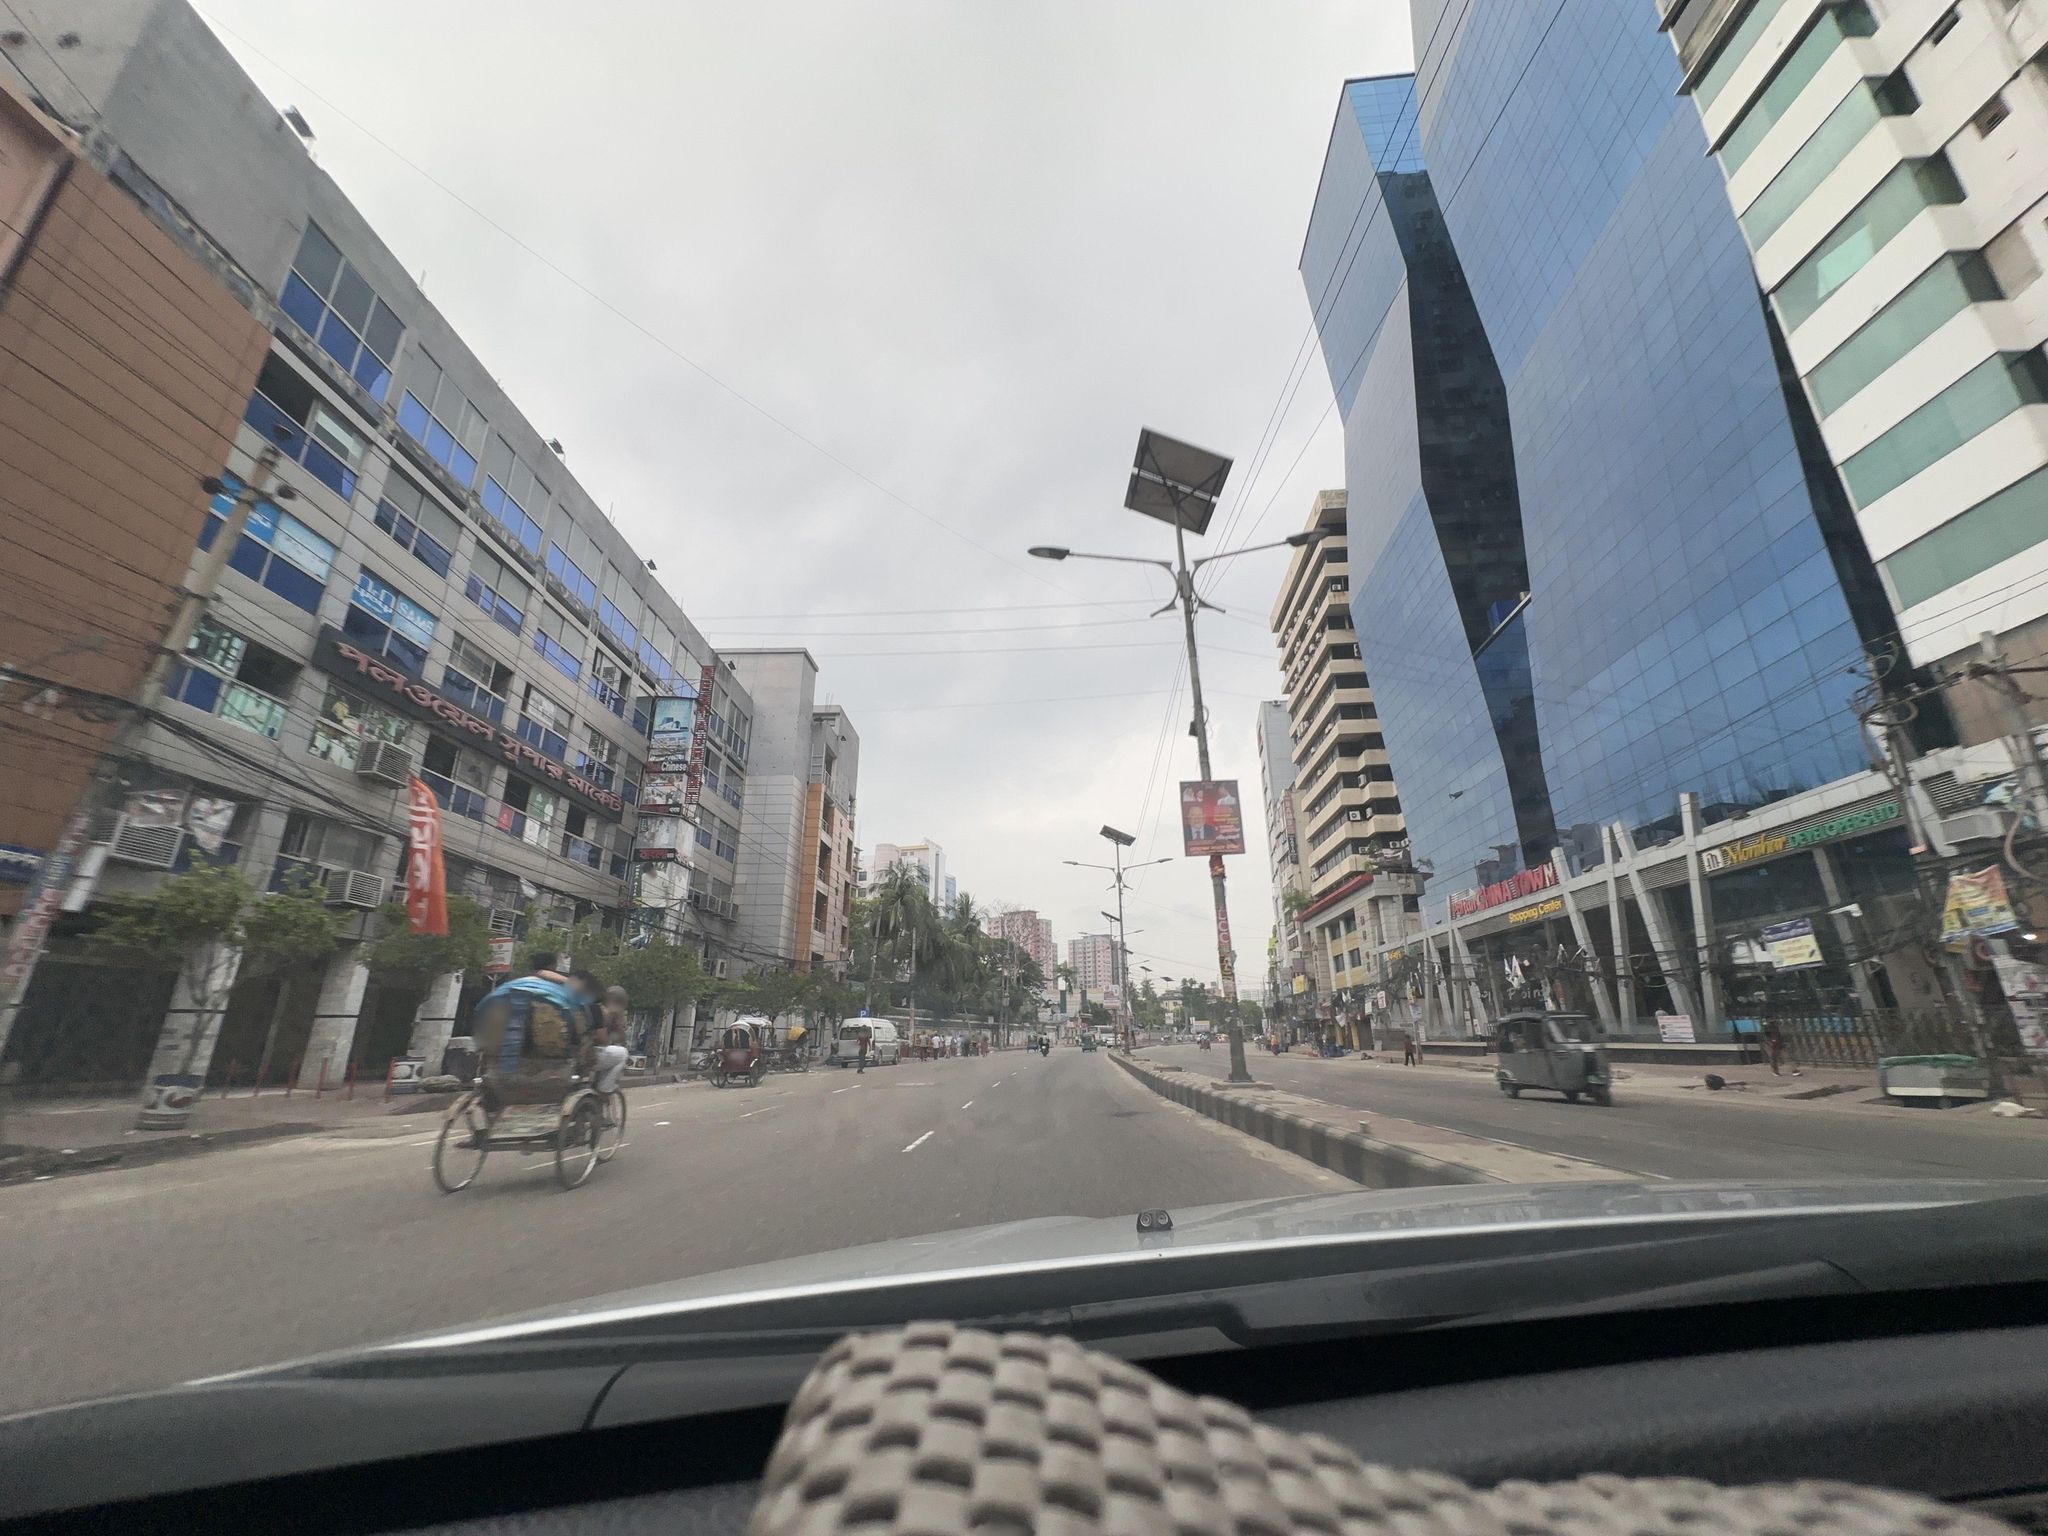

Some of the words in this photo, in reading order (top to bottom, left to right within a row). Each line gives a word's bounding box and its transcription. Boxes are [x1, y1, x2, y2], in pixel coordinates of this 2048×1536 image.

[500, 732, 565, 781] সুপার
[567, 771, 625, 811] মার্কেট
[660, 760, 688, 773] Chinese
[1476, 880, 1514, 912] CHINA
[1512, 861, 1559, 897] TOWN
[1508, 905, 1539, 924] Shopping
[1538, 898, 1563, 916] Center
